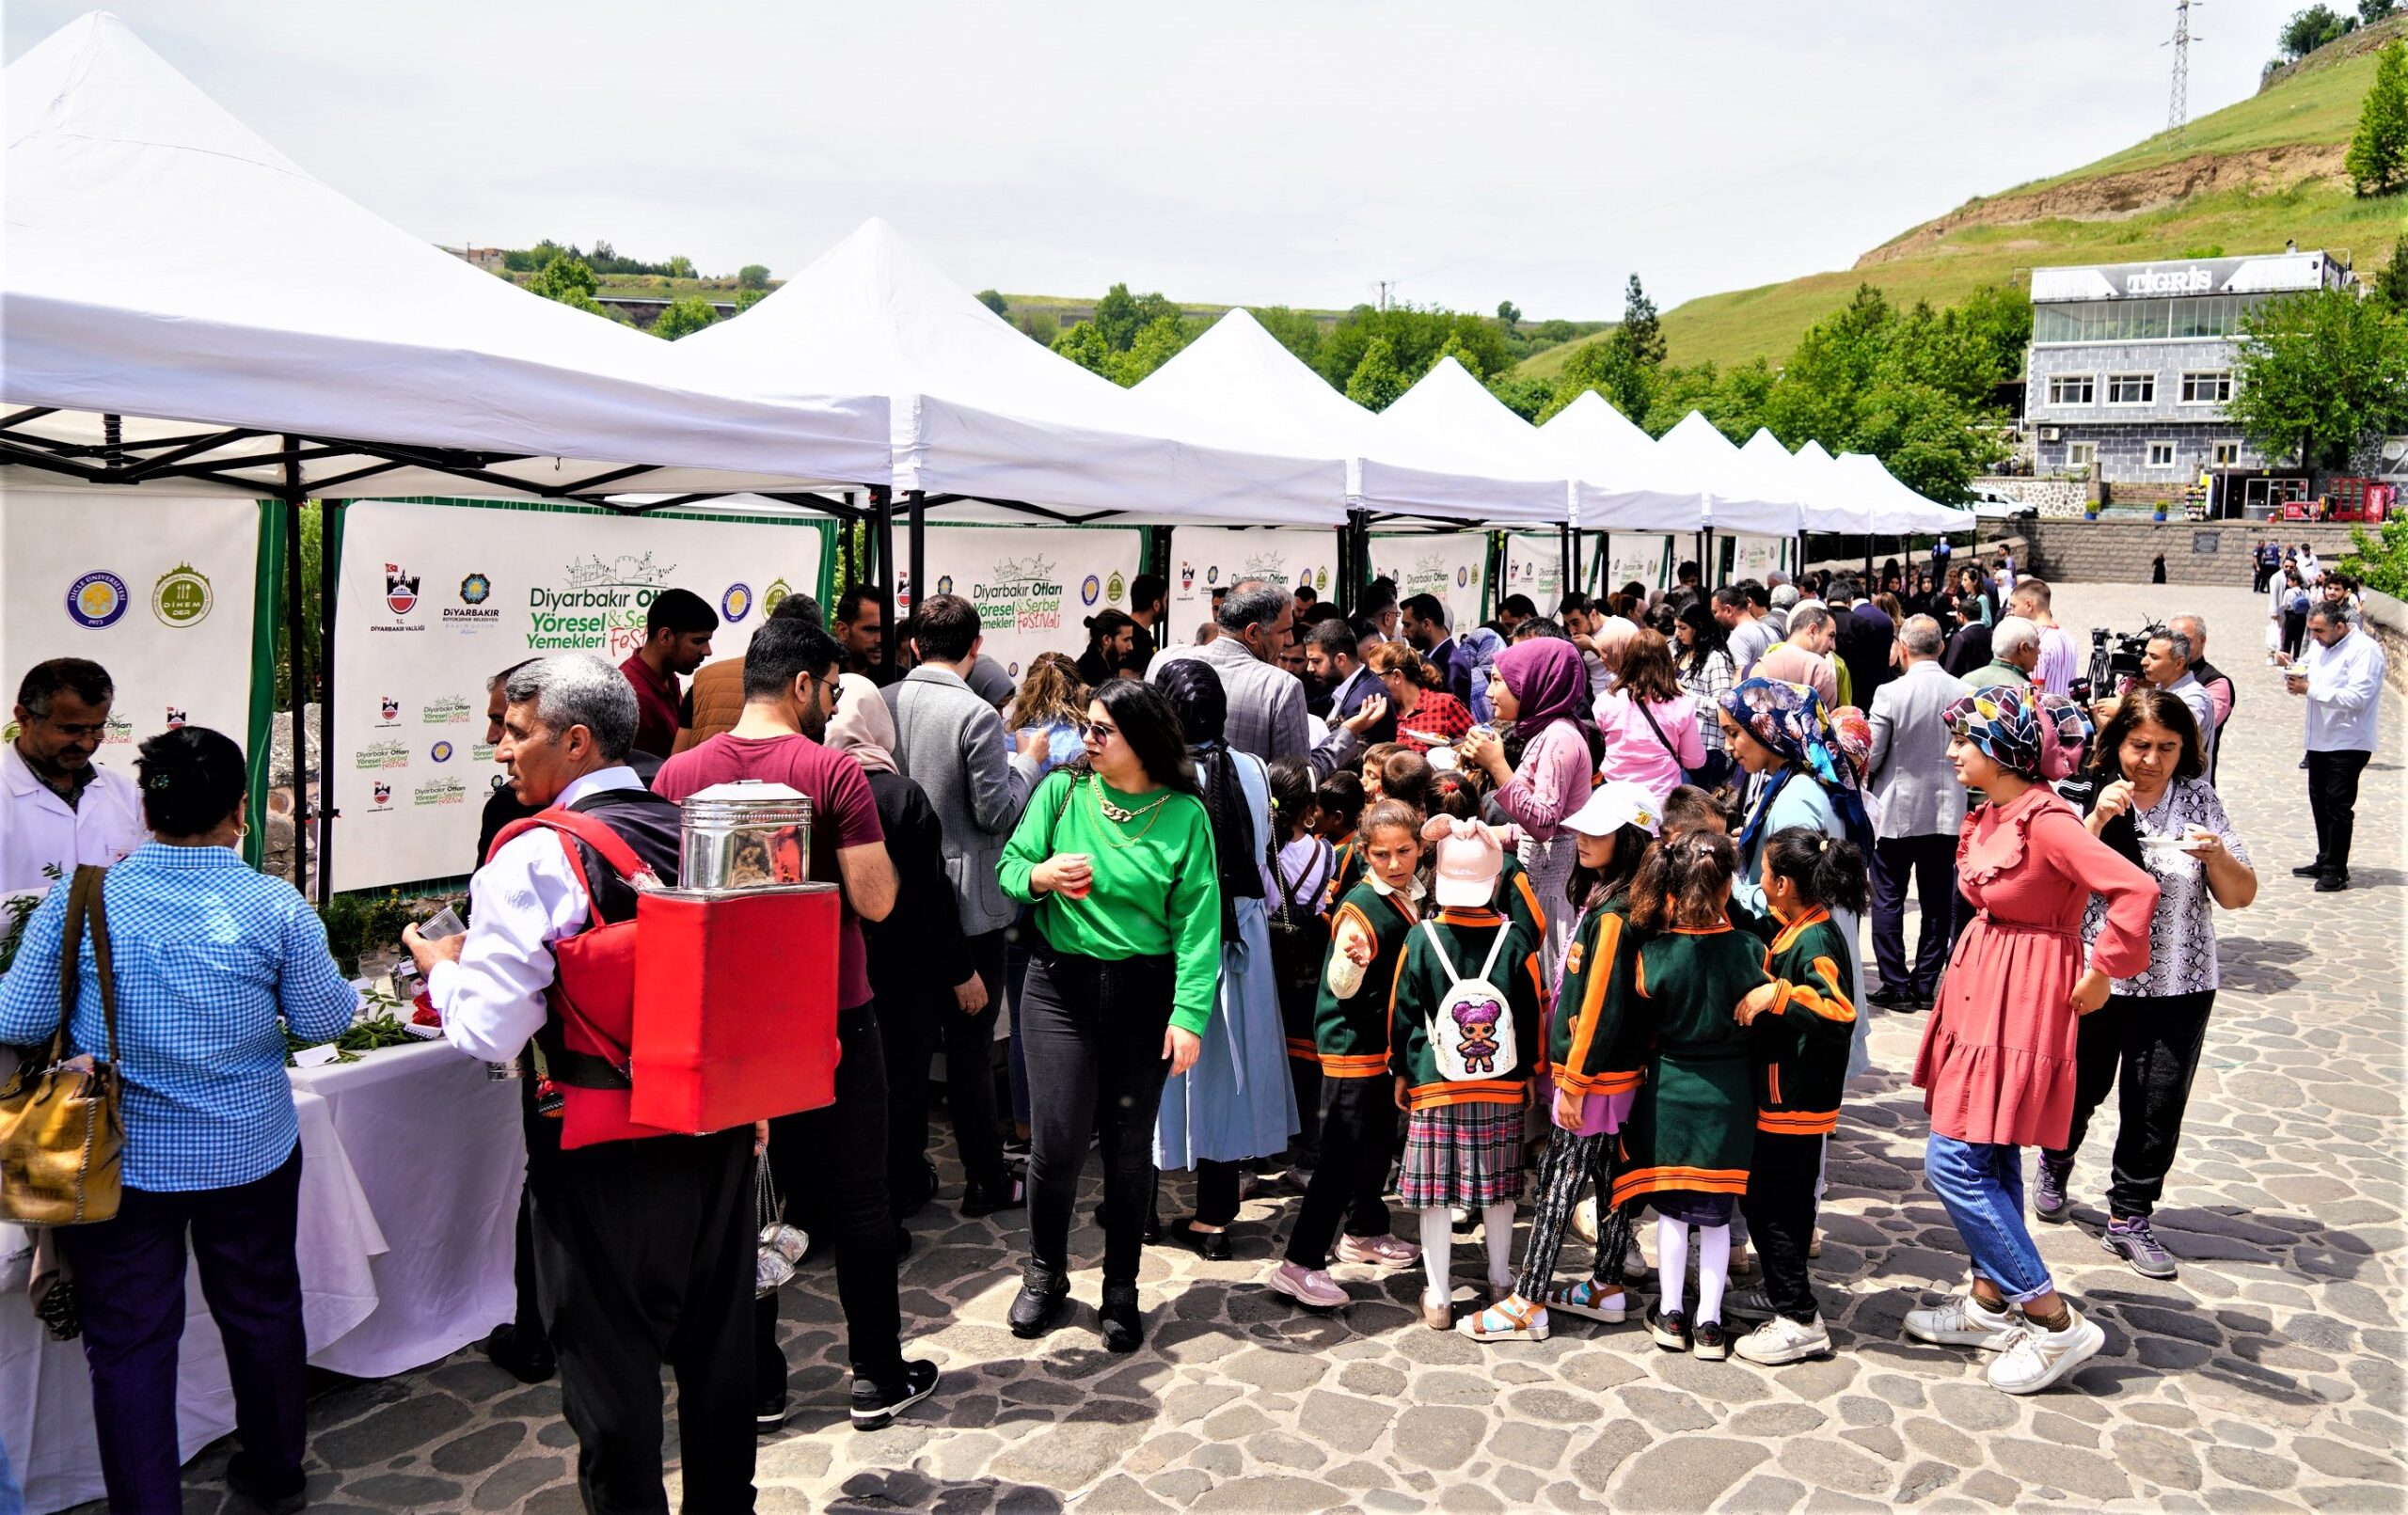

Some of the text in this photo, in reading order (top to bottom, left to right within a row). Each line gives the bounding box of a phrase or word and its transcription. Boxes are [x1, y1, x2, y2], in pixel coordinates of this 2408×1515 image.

[70, 578, 85, 601] DİCLE
[86, 574, 126, 601] ÜNİVERSİTESİ
[974, 584, 1029, 602] Diyarbakır
[1032, 582, 1063, 596] Otları
[530, 588, 630, 611] Diyarbakır
[974, 601, 1016, 617] Yöresel
[443, 608, 499, 617] DİYARBAKIR
[531, 612, 606, 632] Yöresel
[608, 609, 622, 627] &
[527, 633, 606, 649] Yemekleri
